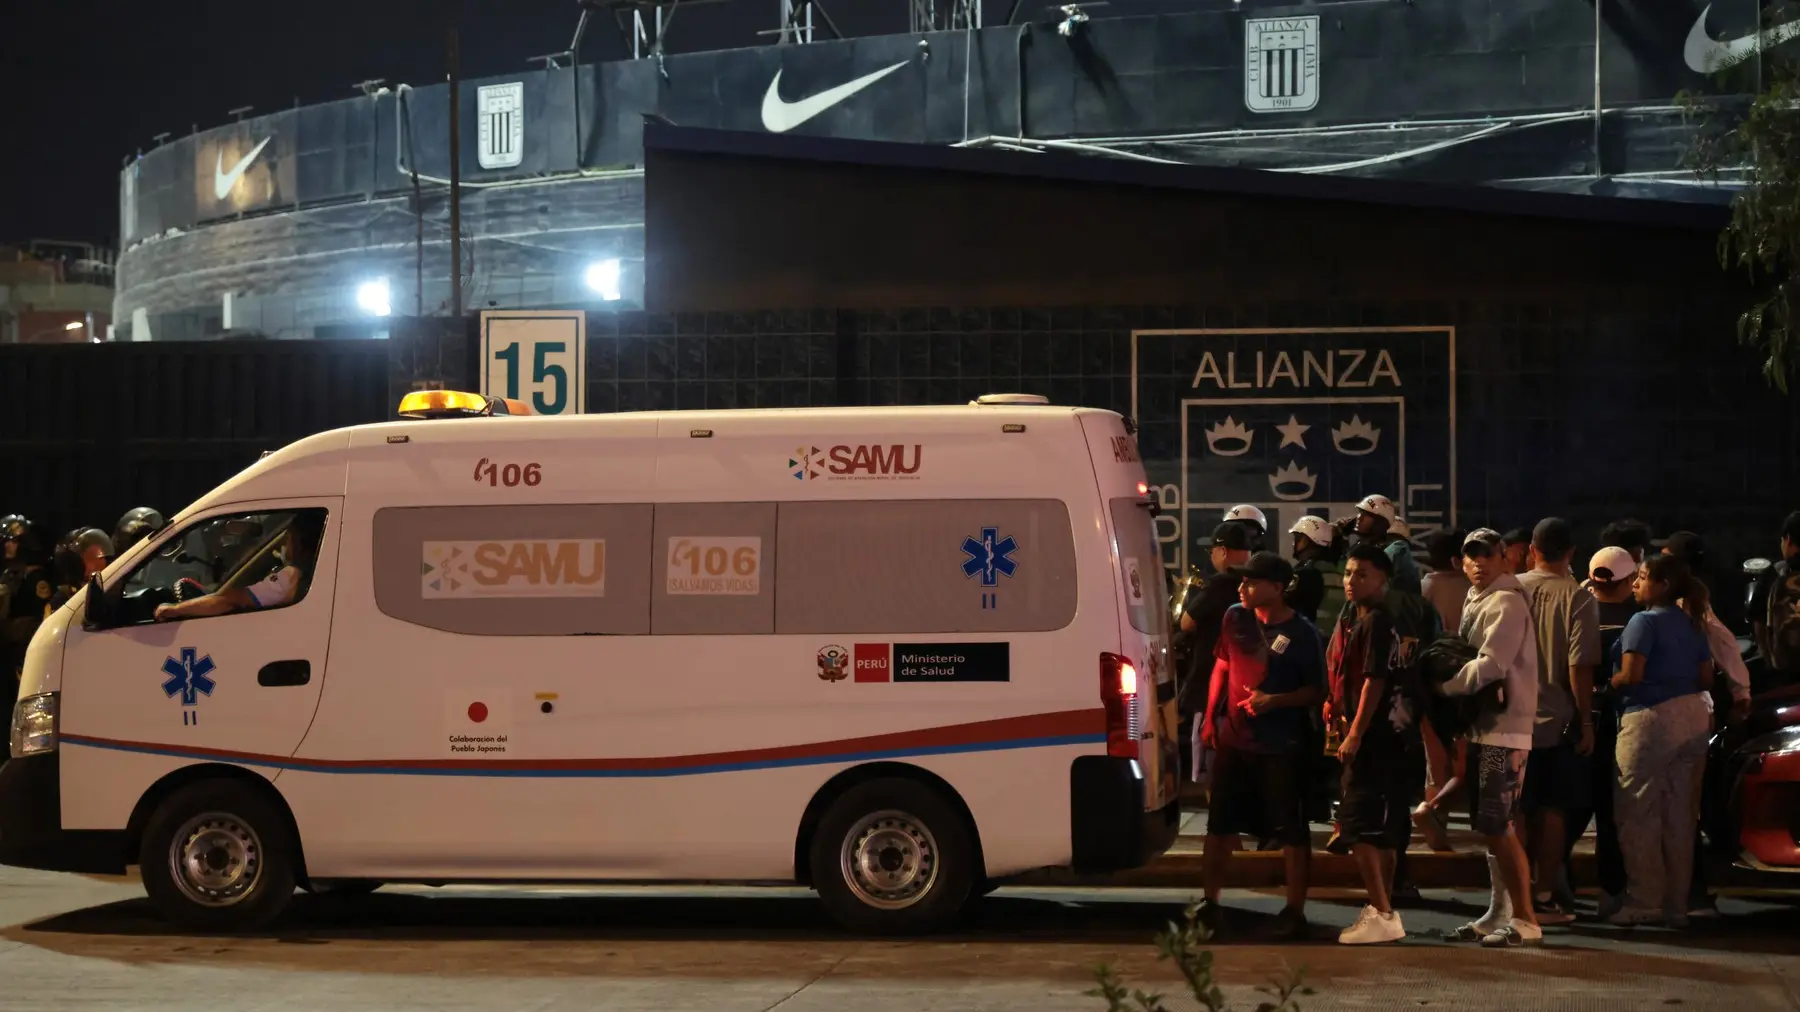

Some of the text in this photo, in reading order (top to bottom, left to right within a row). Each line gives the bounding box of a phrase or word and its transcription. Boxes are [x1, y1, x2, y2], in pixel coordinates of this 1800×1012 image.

[1272, 99, 1292, 108] 1901
[494, 342, 568, 416] 15
[1191, 349, 1402, 389] ALIANZA
[483, 462, 542, 487] 106
[828, 444, 922, 475] SAMU
[1149, 483, 1181, 569] LUB
[1407, 483, 1444, 572] LIM
[472, 542, 604, 587] SAMU
[682, 546, 757, 577] 106
[856, 657, 888, 669] PERÚ
[901, 654, 965, 664] Ministerio
[901, 667, 955, 676] de Salud
[477, 745, 506, 753] Japonés
